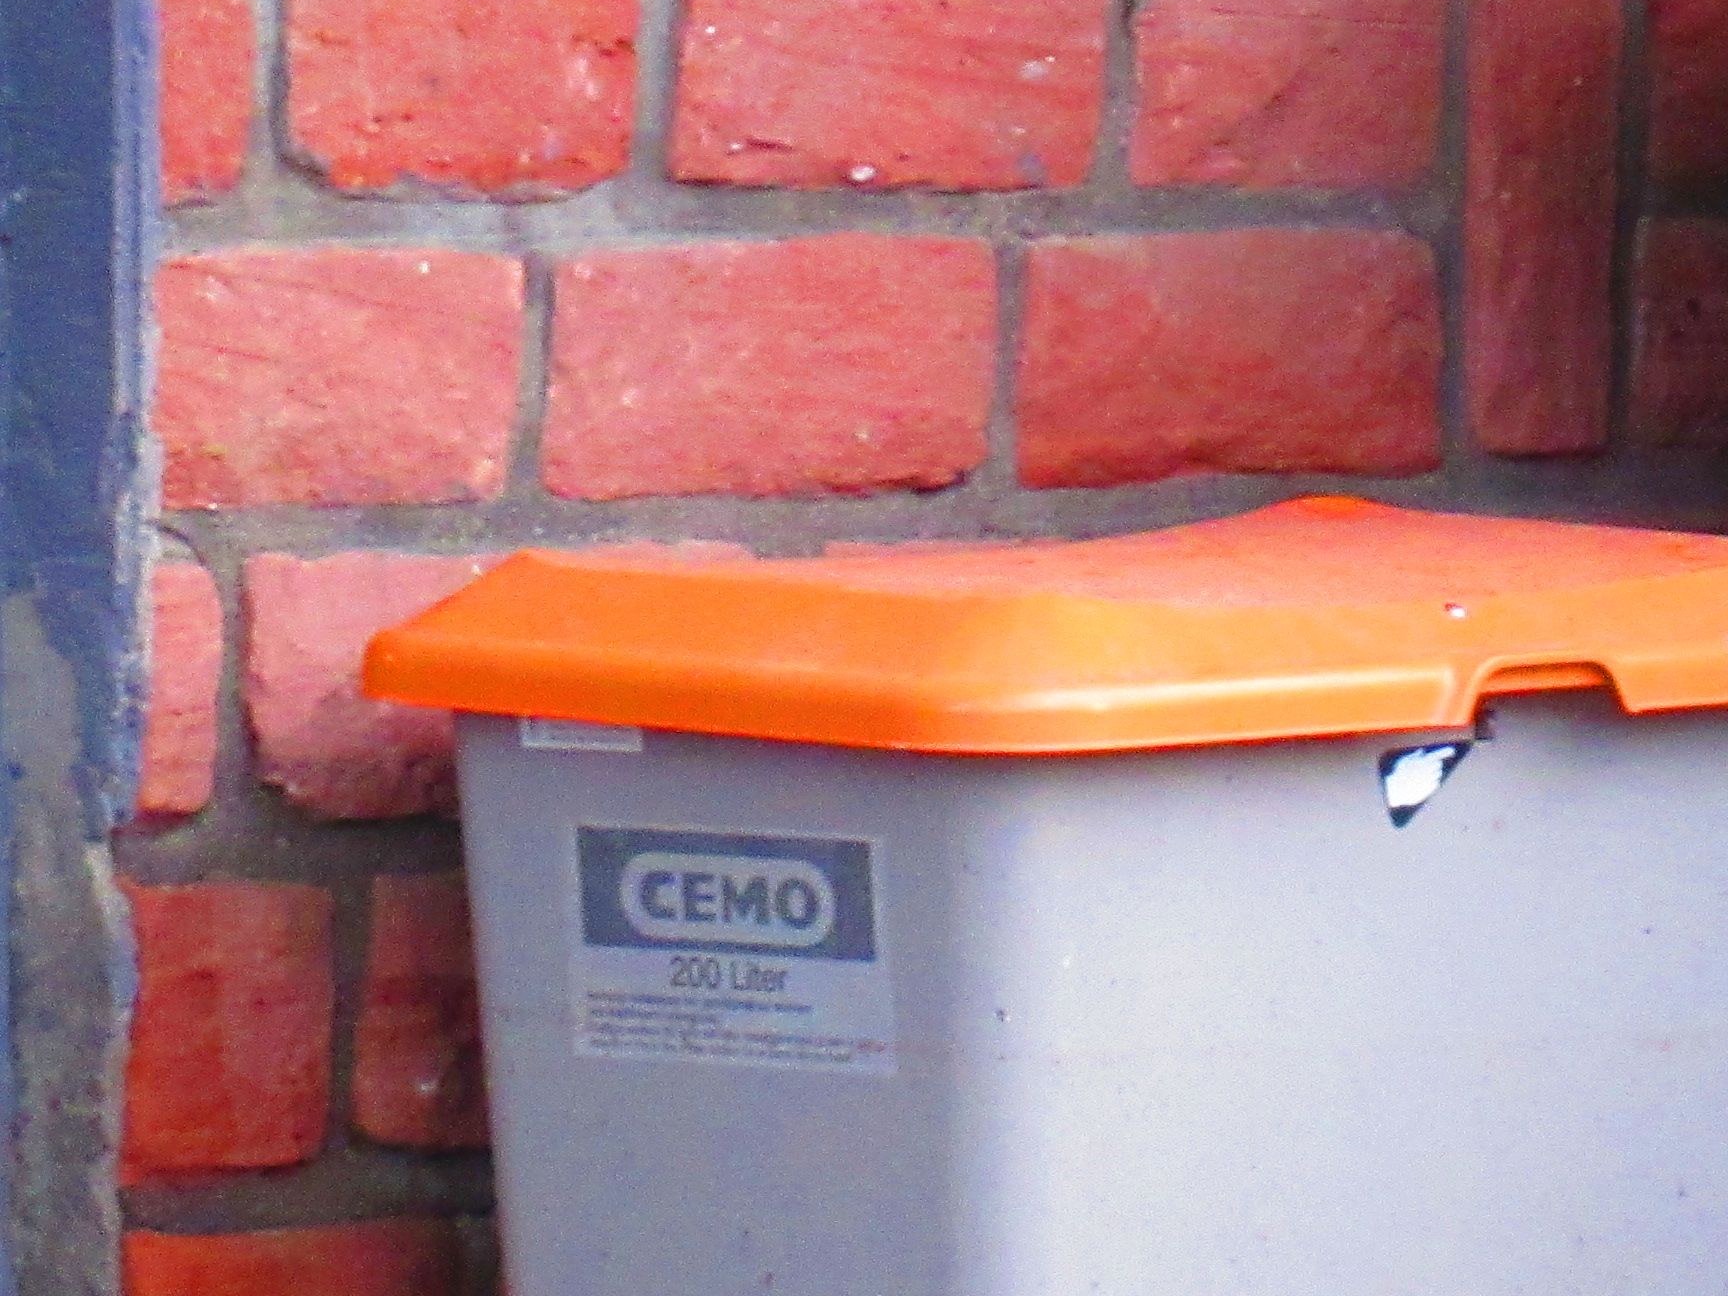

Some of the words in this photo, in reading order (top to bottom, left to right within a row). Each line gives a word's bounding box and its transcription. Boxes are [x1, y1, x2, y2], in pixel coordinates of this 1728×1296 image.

[640, 870, 819, 931] CEMO
[670, 955, 721, 990] 200
[732, 958, 788, 993] Liter
